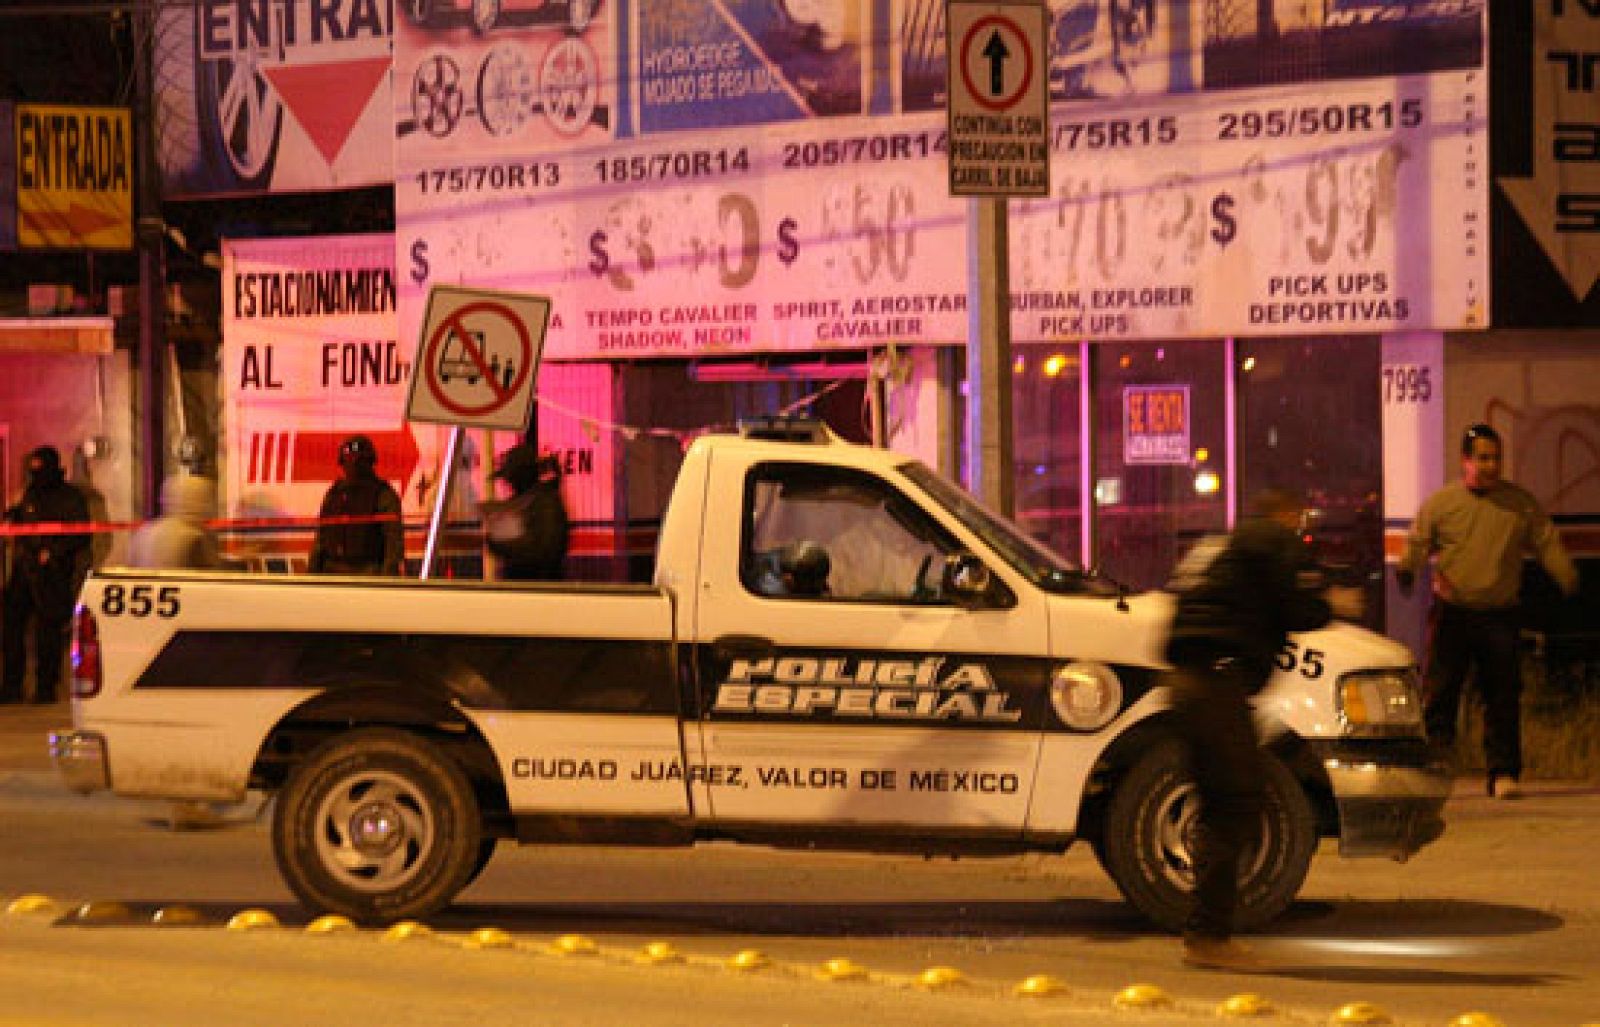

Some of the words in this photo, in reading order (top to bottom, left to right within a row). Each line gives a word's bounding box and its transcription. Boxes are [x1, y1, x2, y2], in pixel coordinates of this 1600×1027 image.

[204, 0, 393, 52] ENTRA
[1050, 116, 1178, 152] /75R15
[1218, 99, 1423, 140] 295/50R15
[19, 113, 129, 191] ENTRADA
[595, 148, 750, 184] 185/70R14
[415, 162, 560, 194] 175/70R13
[1210, 191, 1237, 252] $
[410, 238, 429, 287] $
[588, 229, 609, 277] $
[1093, 287, 1194, 309] EXPLORER
[1269, 274, 1328, 297] PICK
[1337, 272, 1388, 294] UPS
[586, 308, 653, 328] TEMPO
[659, 302, 758, 324] CAVALIER
[851, 294, 967, 316] AEROSTAR
[1248, 296, 1409, 323] DEPORTIVAS
[598, 327, 687, 350] SHADOW,
[694, 325, 751, 345] NEON
[816, 319, 922, 341] CAVALIER
[1040, 315, 1084, 335] PICK
[1090, 313, 1129, 334] UPS
[241, 343, 283, 390] AL
[102, 584, 181, 618] 855
[728, 656, 998, 691] POLICÍA
[1276, 640, 1324, 679] 55
[709, 683, 1022, 722] ESPECIAL
[511, 758, 618, 781] CIUDAD
[757, 766, 848, 790] VALOR
[860, 769, 897, 791] DE
